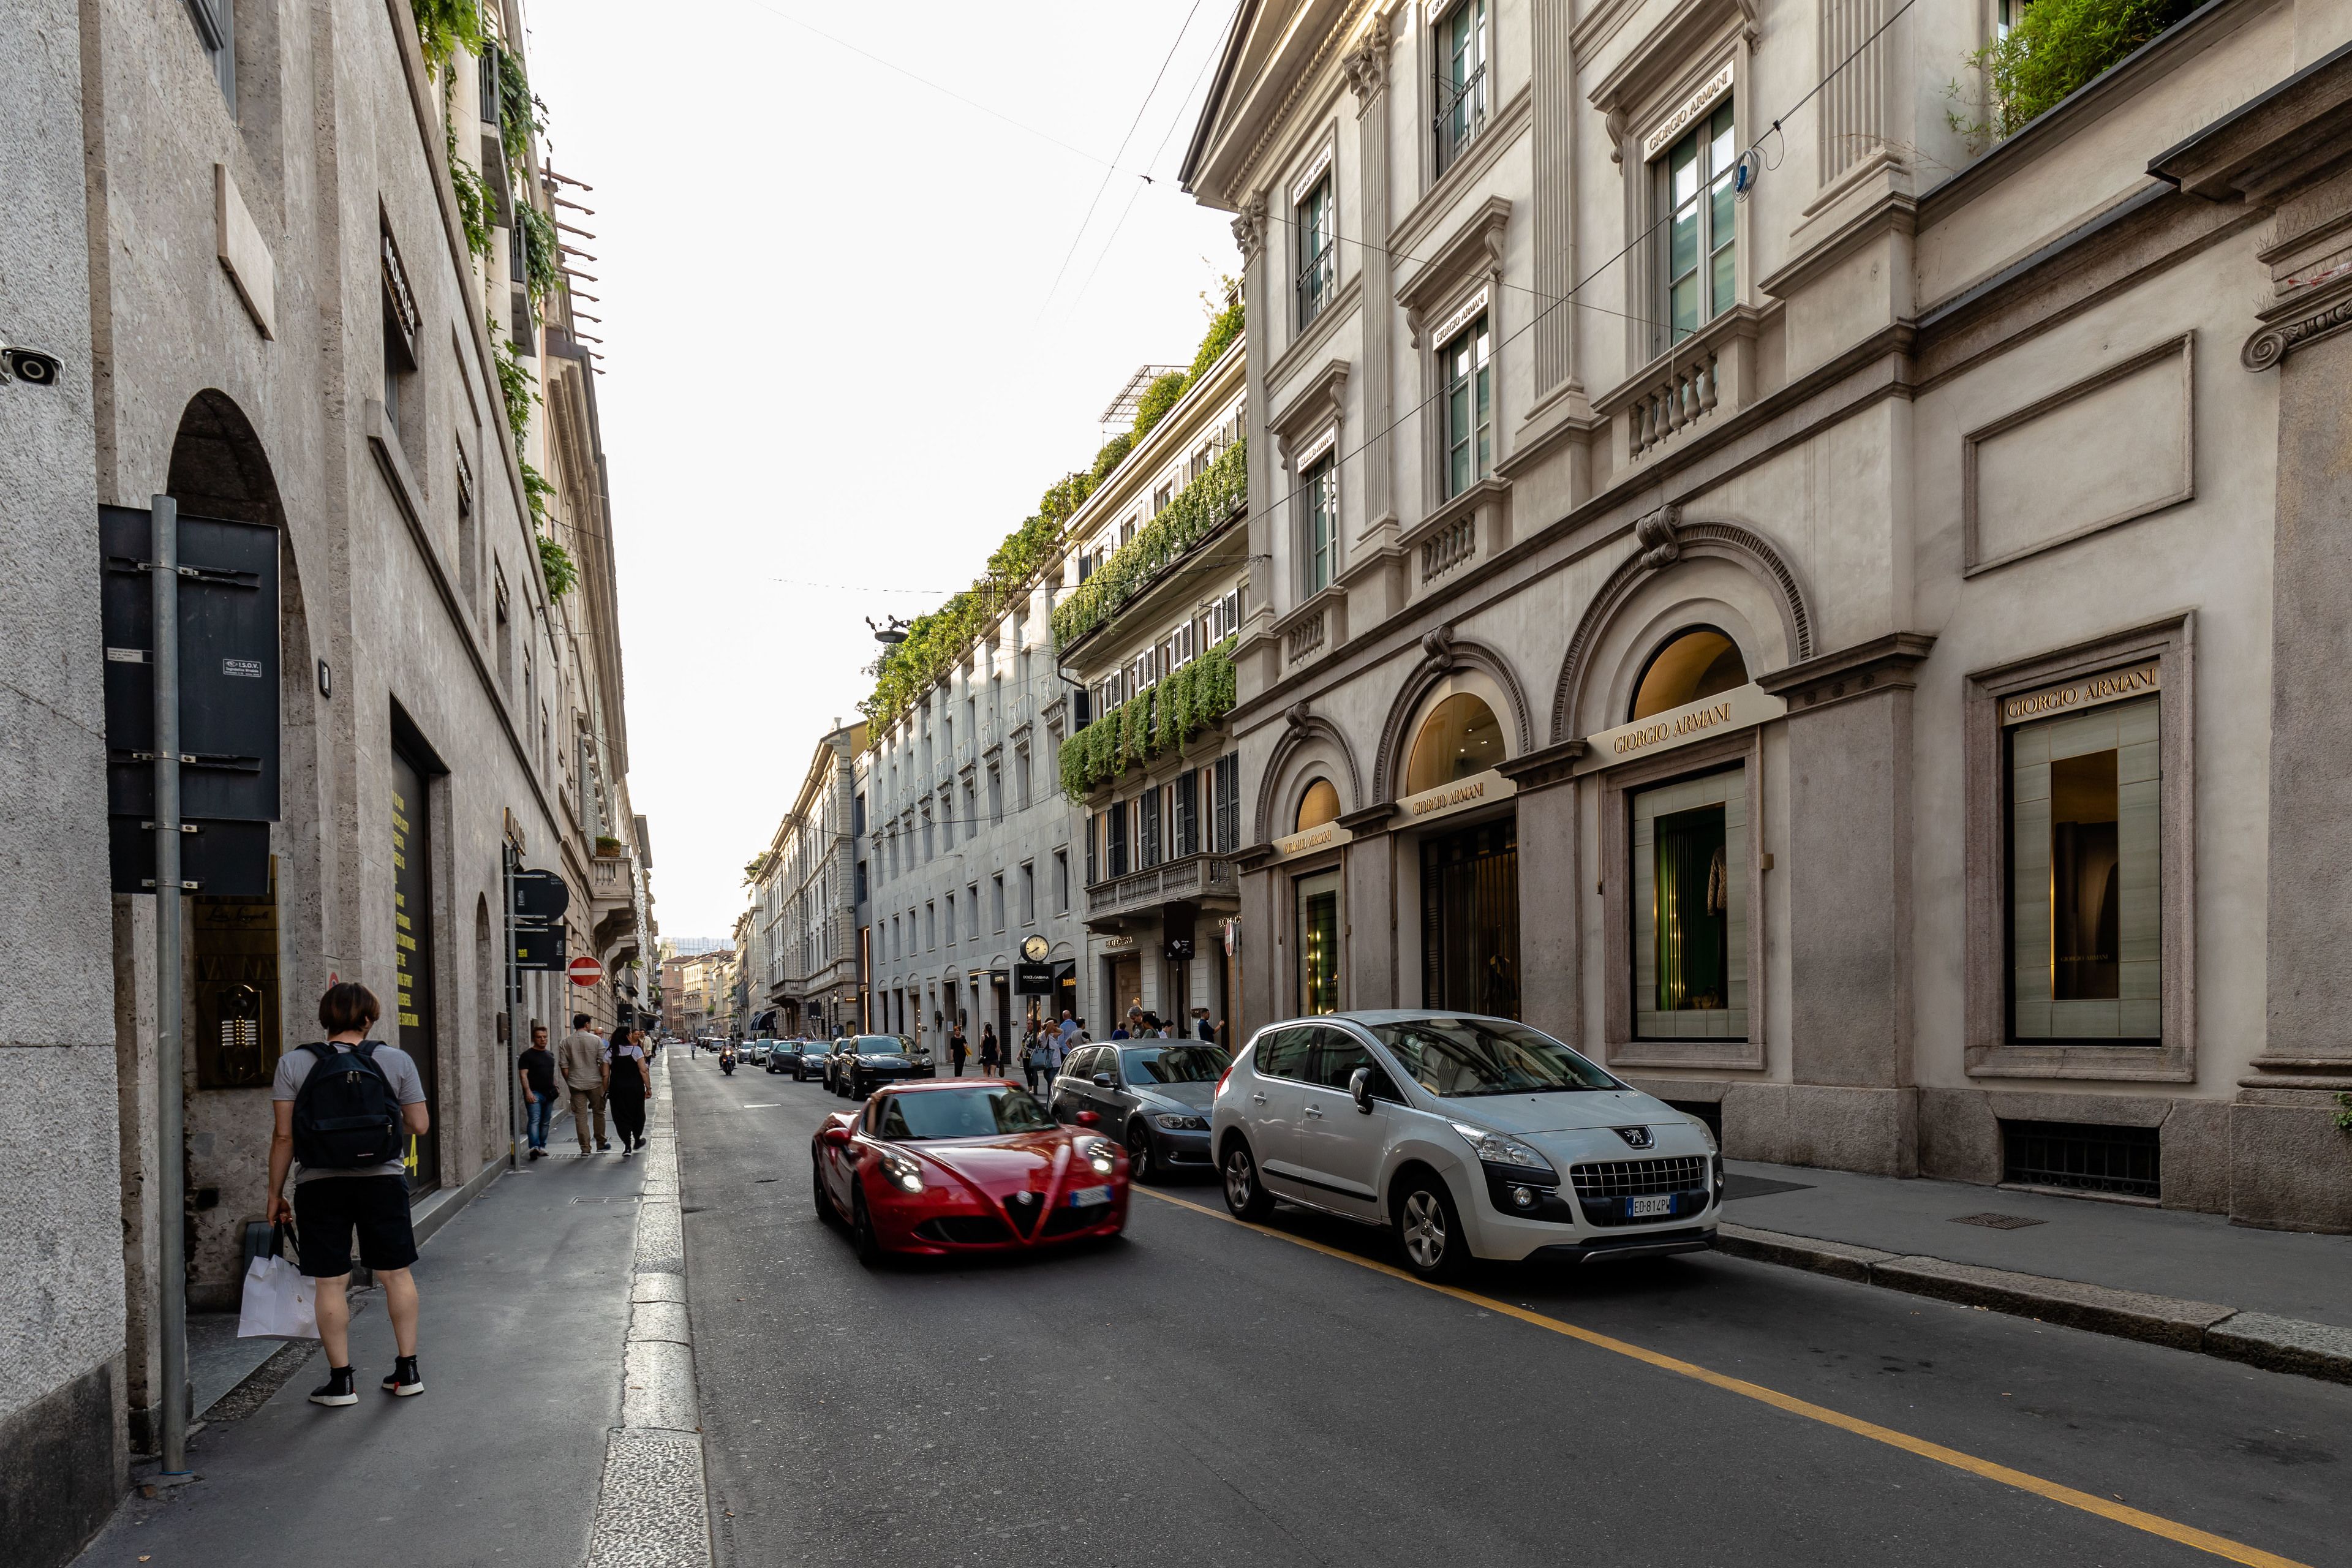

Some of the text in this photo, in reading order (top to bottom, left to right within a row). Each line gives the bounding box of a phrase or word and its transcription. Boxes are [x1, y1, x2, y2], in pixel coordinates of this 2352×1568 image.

[1649, 70, 1728, 151] GIORGIO ARMANI
[386, 235, 415, 336] MONCLER
[1436, 293, 1484, 342] GIORGIO ARMANI
[2008, 667, 2155, 718] GIORGIO ARMANI
[1614, 702, 1731, 754] GIORGIO ARMANI
[1412, 782, 1483, 816] GIORGIO ARMANI
[1283, 830, 1332, 855] GIORGIO ARMANI
